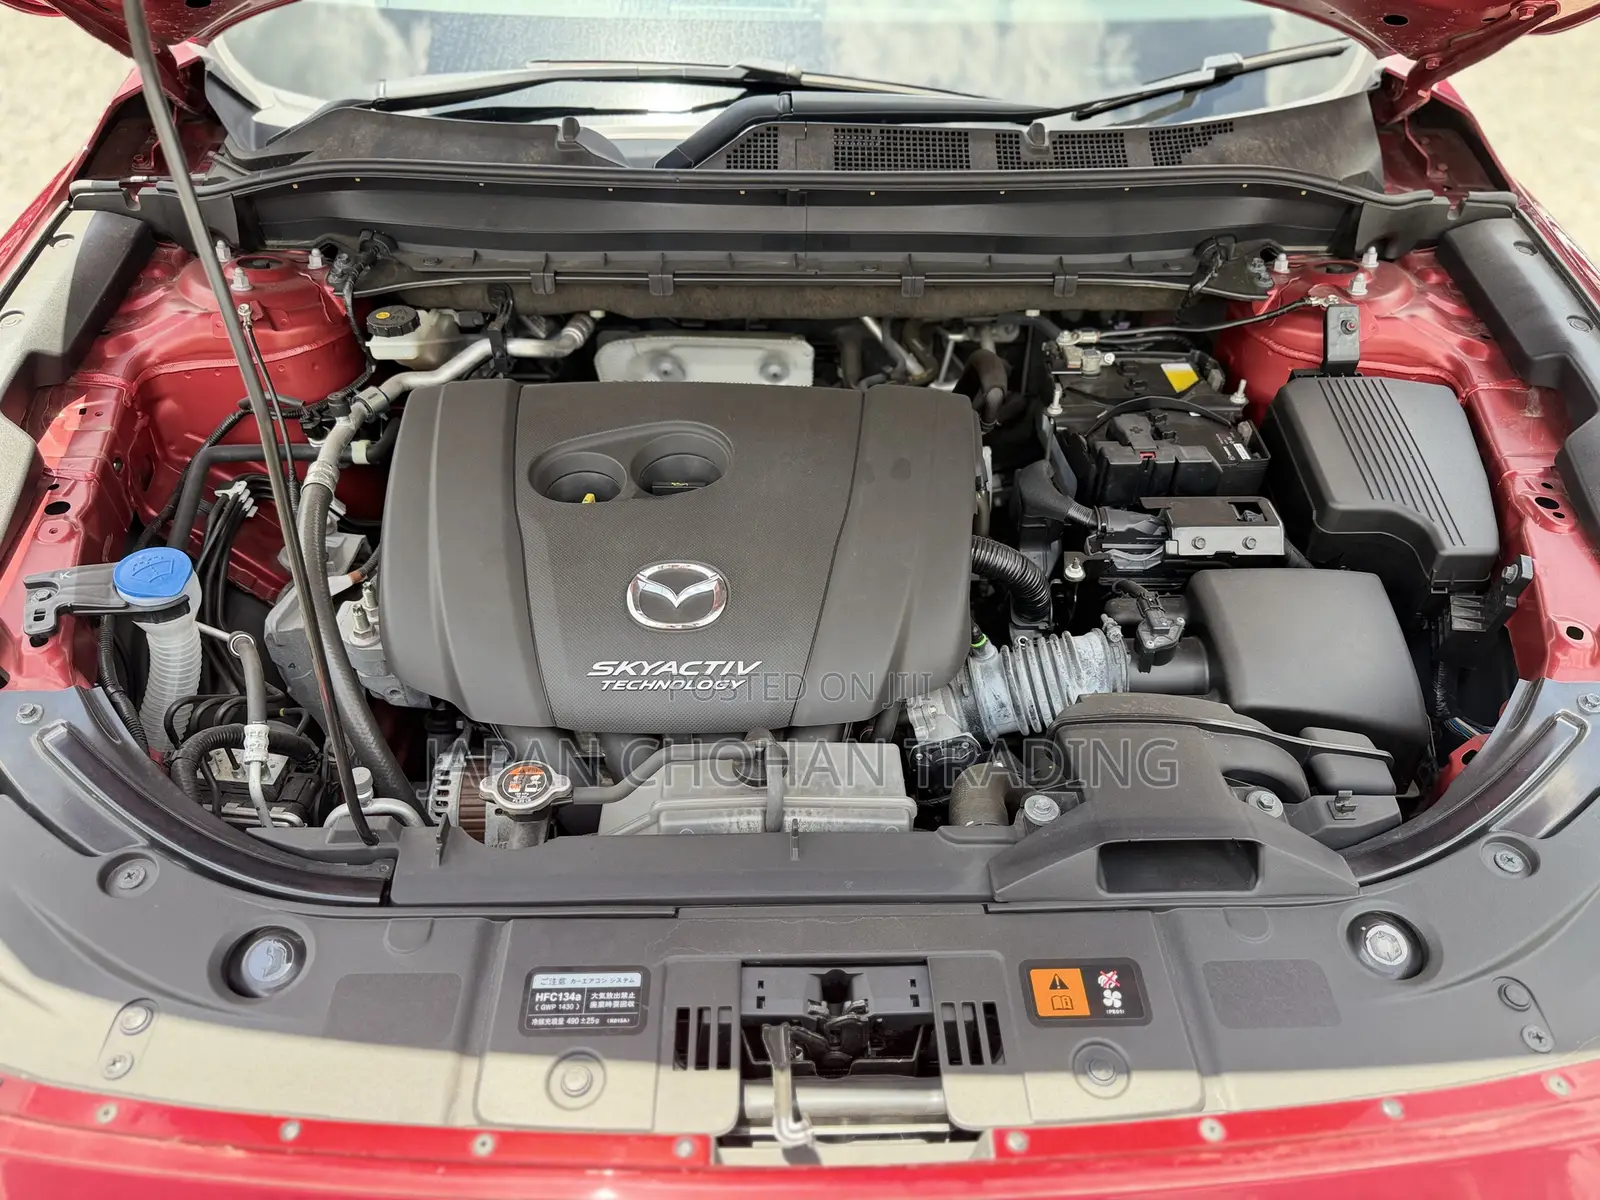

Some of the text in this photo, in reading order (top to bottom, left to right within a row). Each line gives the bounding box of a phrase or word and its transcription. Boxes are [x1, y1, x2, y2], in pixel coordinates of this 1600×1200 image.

[586, 660, 763, 676] SKYACTIV
[600, 679, 747, 691] TECHNOLOGY
[535, 992, 582, 1001] HFC134a
